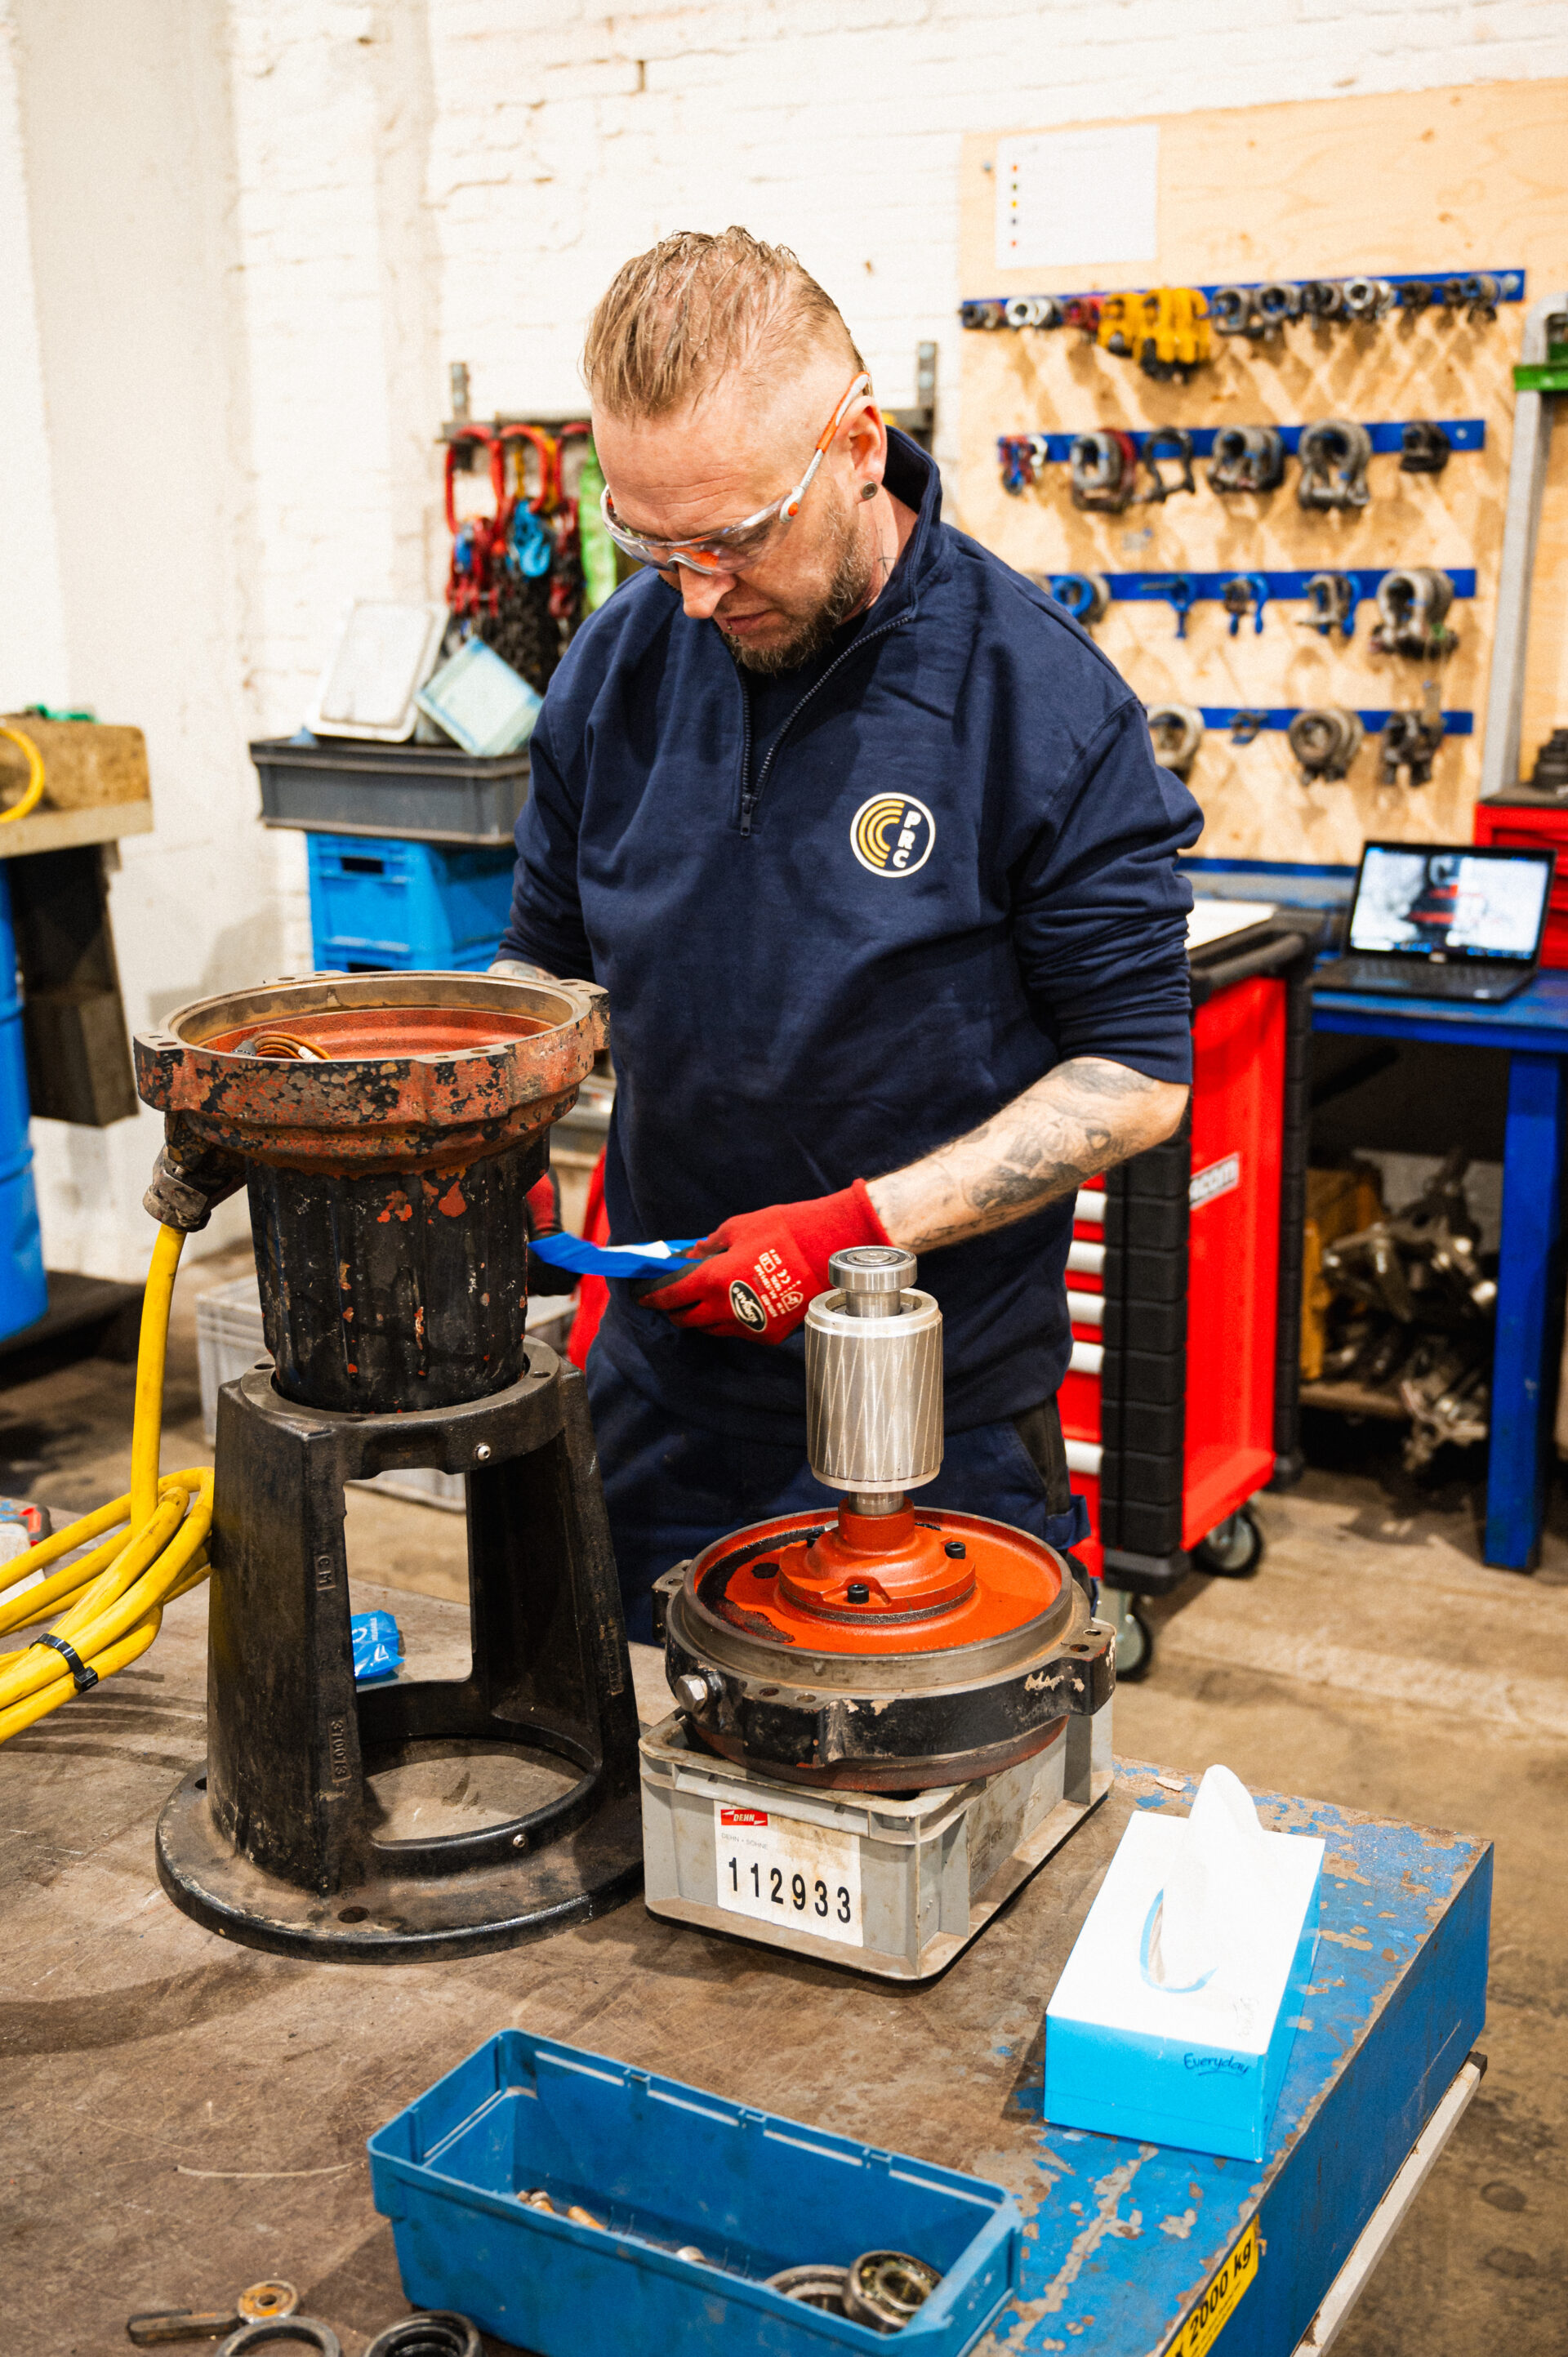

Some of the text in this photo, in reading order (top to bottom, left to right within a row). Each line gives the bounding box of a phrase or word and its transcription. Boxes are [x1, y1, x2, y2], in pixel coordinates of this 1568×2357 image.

[892, 810, 922, 869] PRC
[733, 1813, 755, 1822] DEHN
[728, 1856, 851, 1923] 112933
[1183, 2052, 1250, 2076] Everyday
[1189, 2270, 1228, 2346] 2000
[1233, 2239, 1251, 2278] kg
